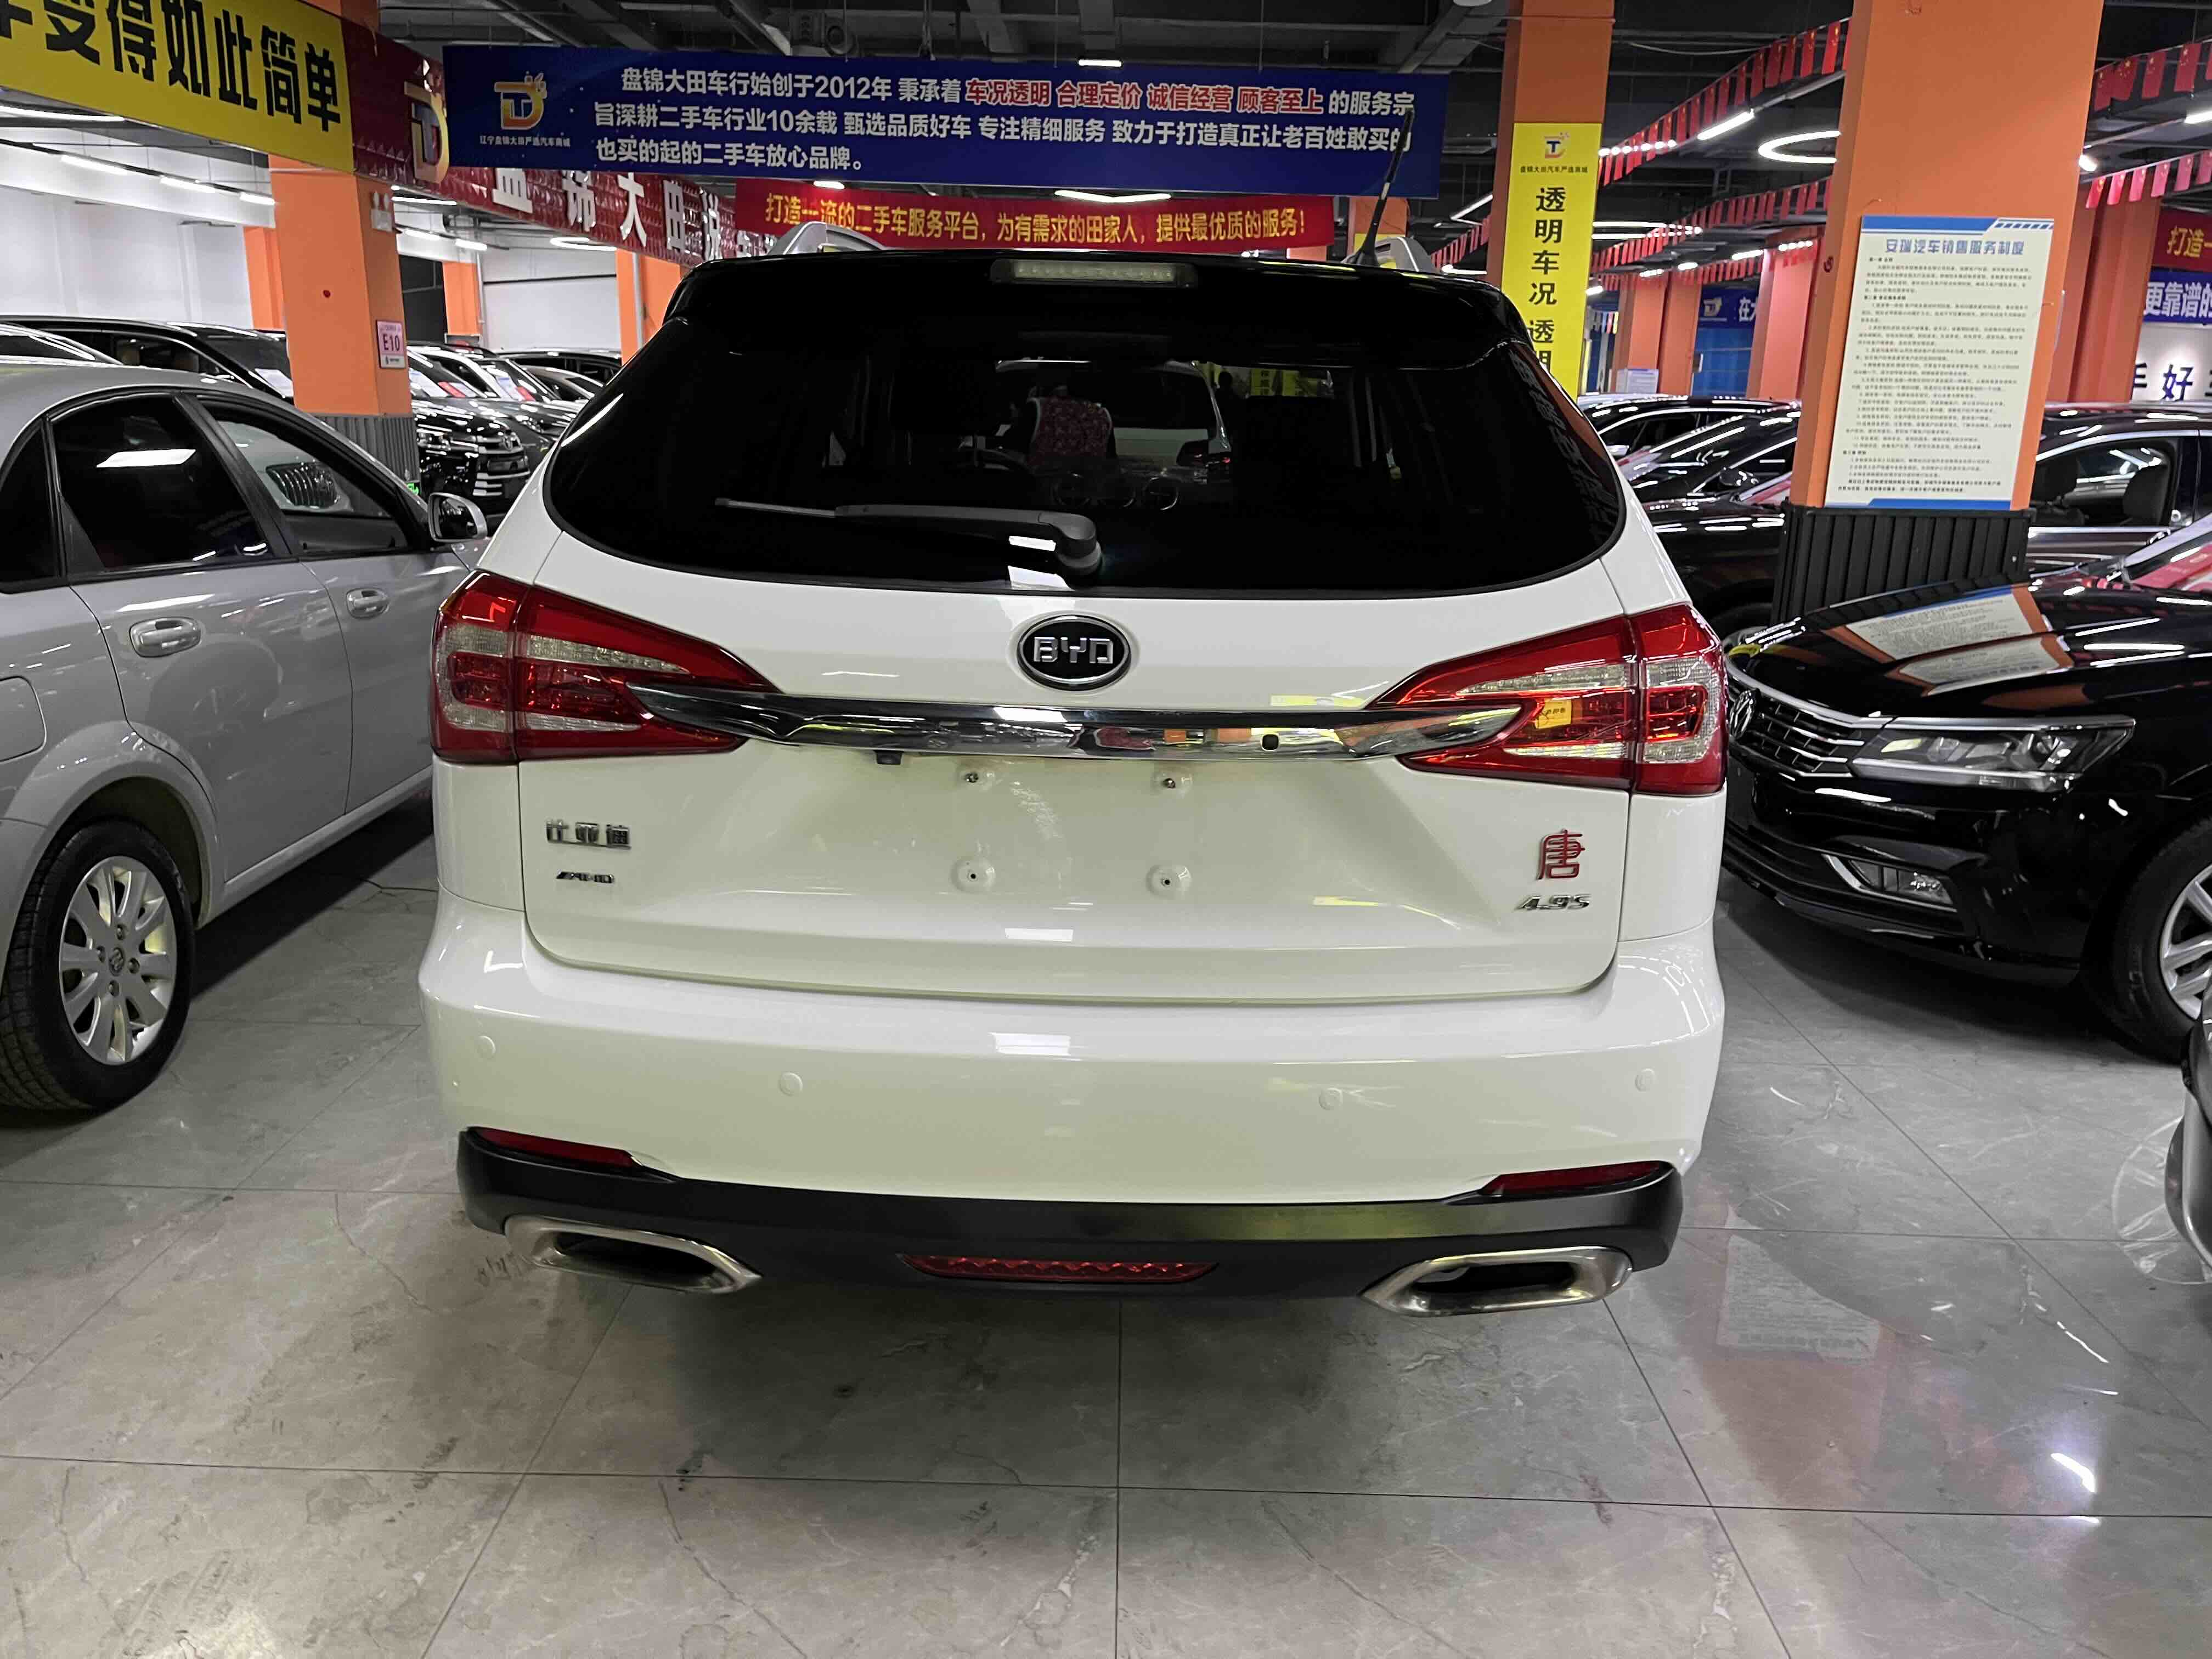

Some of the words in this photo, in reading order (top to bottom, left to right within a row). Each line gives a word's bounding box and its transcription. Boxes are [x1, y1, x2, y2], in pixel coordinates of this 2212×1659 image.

[621, 67, 893, 101] 盘锦大田车行始创于2012年
[898, 77, 962, 103] 秉承着
[966, 78, 1051, 105] 车况透明
[1057, 81, 1142, 109] 合理定价
[1147, 83, 1233, 112] 诚信经营
[1237, 87, 1324, 114] 顾客至上
[1328, 90, 1415, 116] 的服务宗
[594, 102, 838, 135] 旨深耕二手车行业10余载
[844, 112, 972, 139] 甄选品质好车
[978, 115, 1106, 142] 专注精细服务
[1112, 119, 1412, 151] 致力于打造真正让老百姓敢买的
[596, 138, 861, 170] 也买的起的二手车放心品牌。
[1528, 187, 1566, 305] 透明车况
[383, 333, 400, 352] E10
[1034, 636, 1114, 664] BYD
[1536, 829, 1585, 881] 唐
